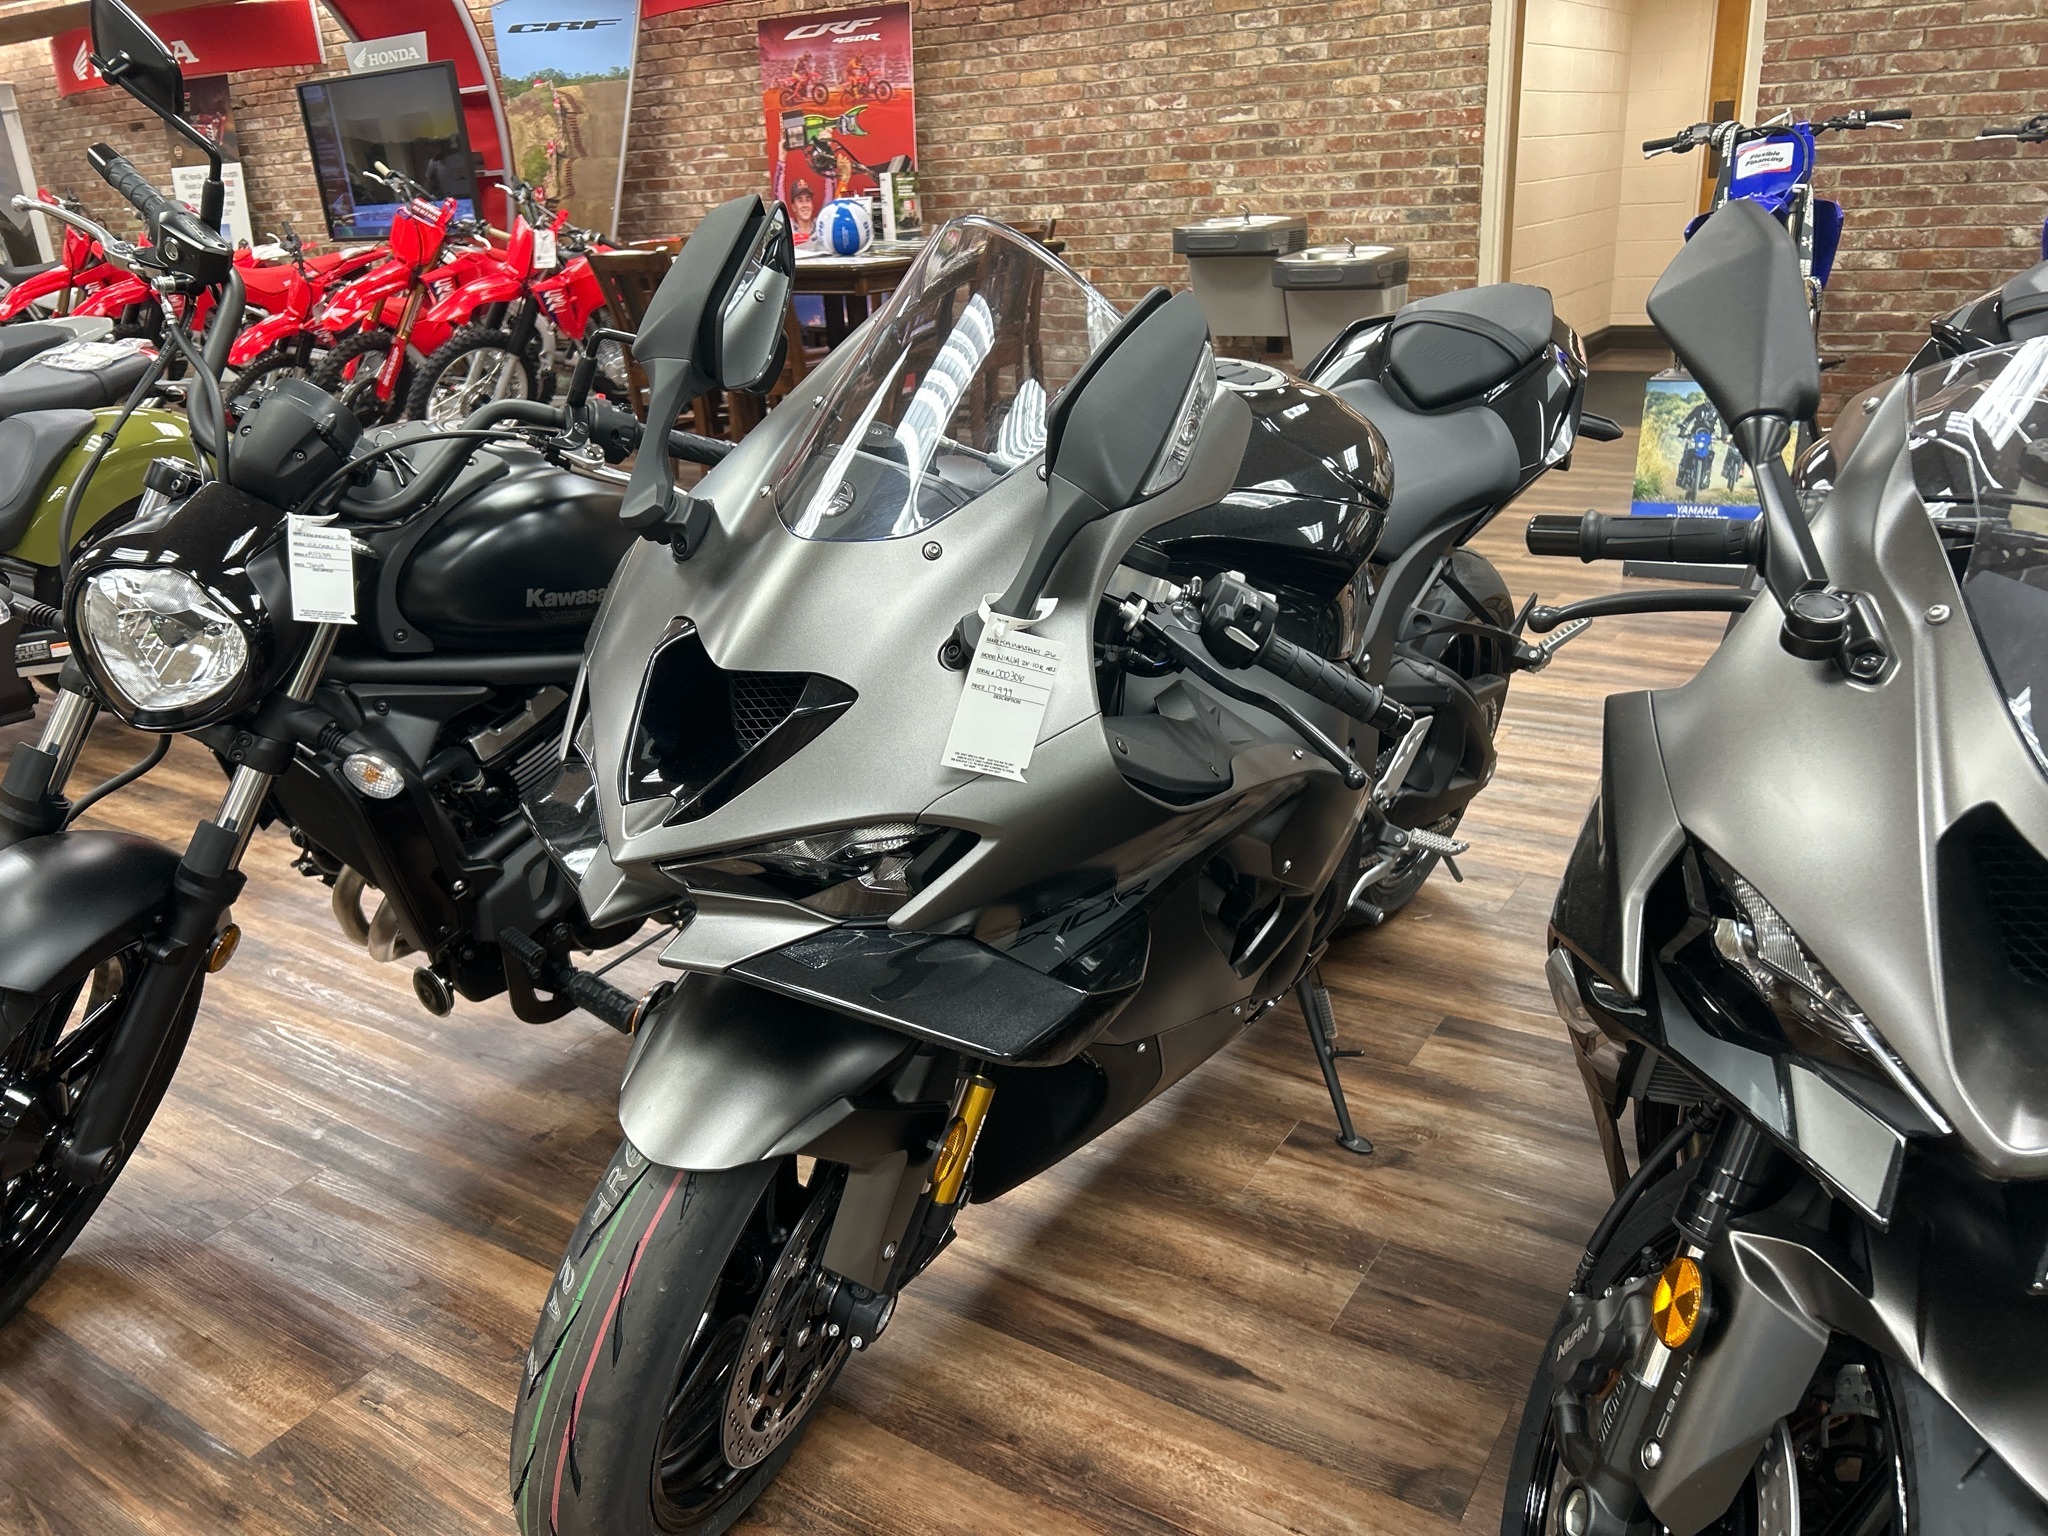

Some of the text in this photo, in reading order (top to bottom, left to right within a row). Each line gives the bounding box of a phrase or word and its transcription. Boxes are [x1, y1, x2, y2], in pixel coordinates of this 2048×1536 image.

[507, 18, 622, 33] CRF
[783, 17, 882, 40] CRF
[832, 33, 881, 43] 450R
[367, 46, 420, 66] HONDA
[1749, 150, 1780, 160] Flexible
[1745, 156, 1784, 166] Financing
[1676, 505, 1719, 516] YAMAHA
[981, 652, 996, 661] MODEL
[976, 667, 990, 676] SERIAL
[971, 682, 985, 691] PRICE
[993, 694, 1021, 705] DESCRIPTION
